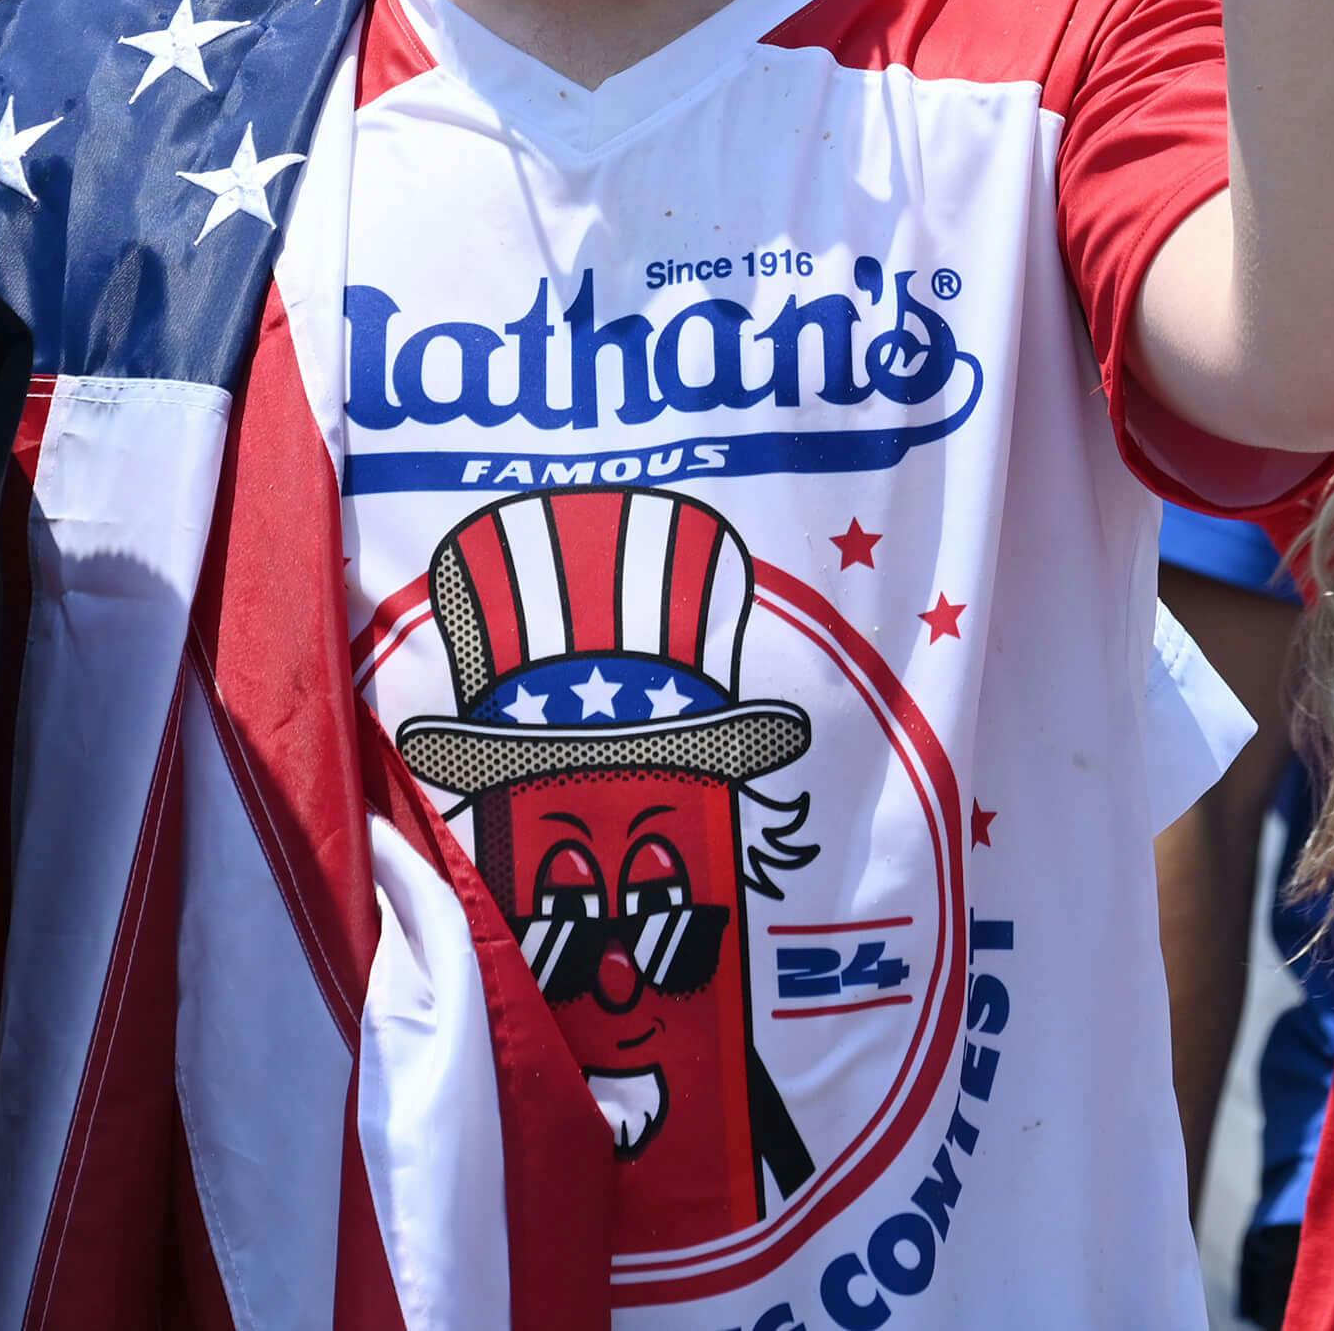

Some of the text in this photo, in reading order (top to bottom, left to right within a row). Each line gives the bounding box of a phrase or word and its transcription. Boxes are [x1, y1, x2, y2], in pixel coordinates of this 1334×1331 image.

[646, 251, 814, 289] Since 1916
[461, 444, 730, 485] FAMOUS
[776, 941, 910, 998] 24
[819, 906, 1015, 1331] CONTEST
